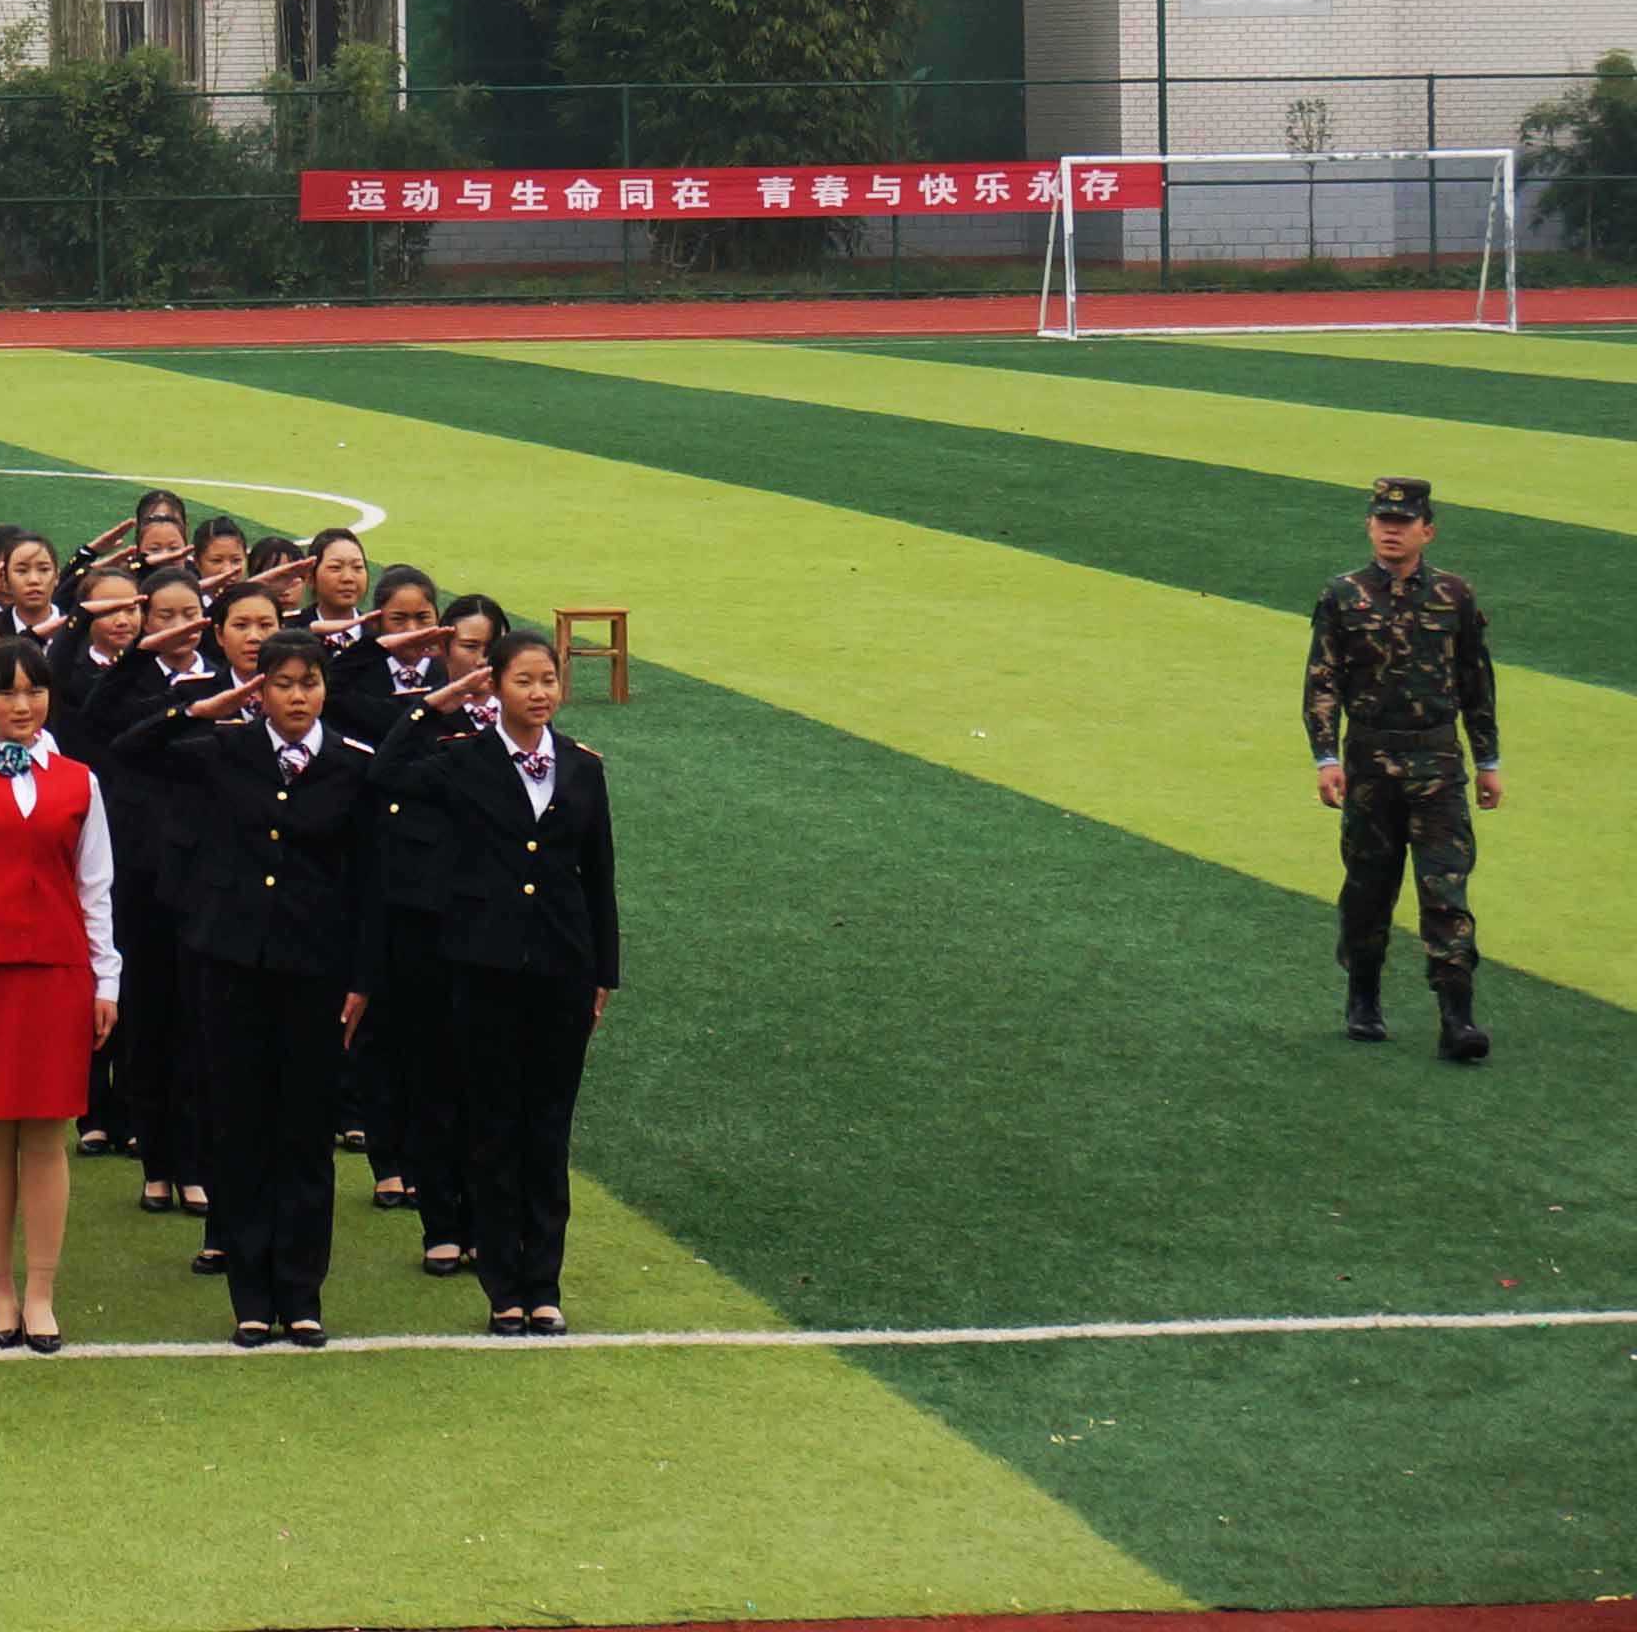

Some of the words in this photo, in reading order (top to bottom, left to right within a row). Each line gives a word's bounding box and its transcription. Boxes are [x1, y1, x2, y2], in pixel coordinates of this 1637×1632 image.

[347, 178, 710, 213] 运动与生命同在
[756, 169, 1120, 209] 青春与快乐永存
